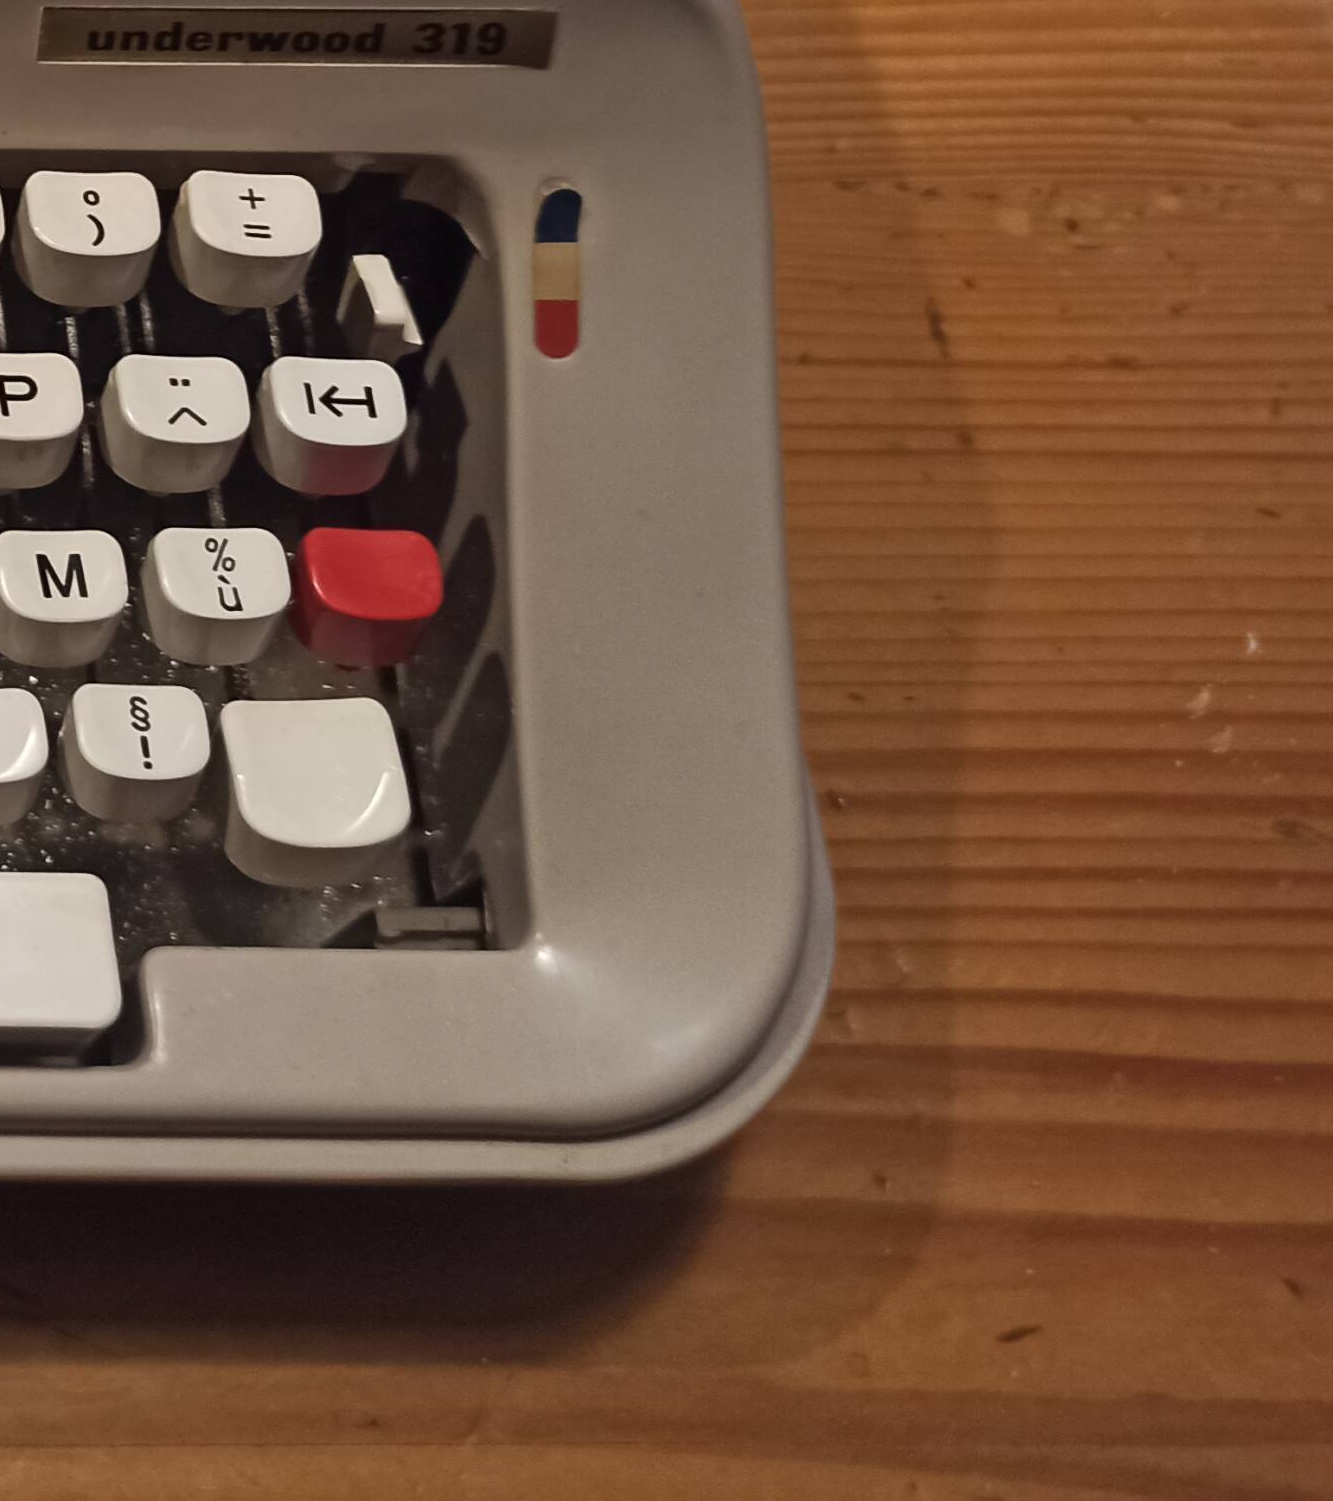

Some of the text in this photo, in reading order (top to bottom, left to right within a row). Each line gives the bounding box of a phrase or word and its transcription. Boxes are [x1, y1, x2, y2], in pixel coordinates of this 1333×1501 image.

[87, 22, 508, 55] underwood 319
[239, 189, 265, 209] +
[88, 215, 104, 246] )
[205, 538, 235, 571] %
[36, 554, 88, 598] M
[218, 575, 243, 611] ù
[130, 697, 150, 731] §
[141, 736, 152, 769] !
